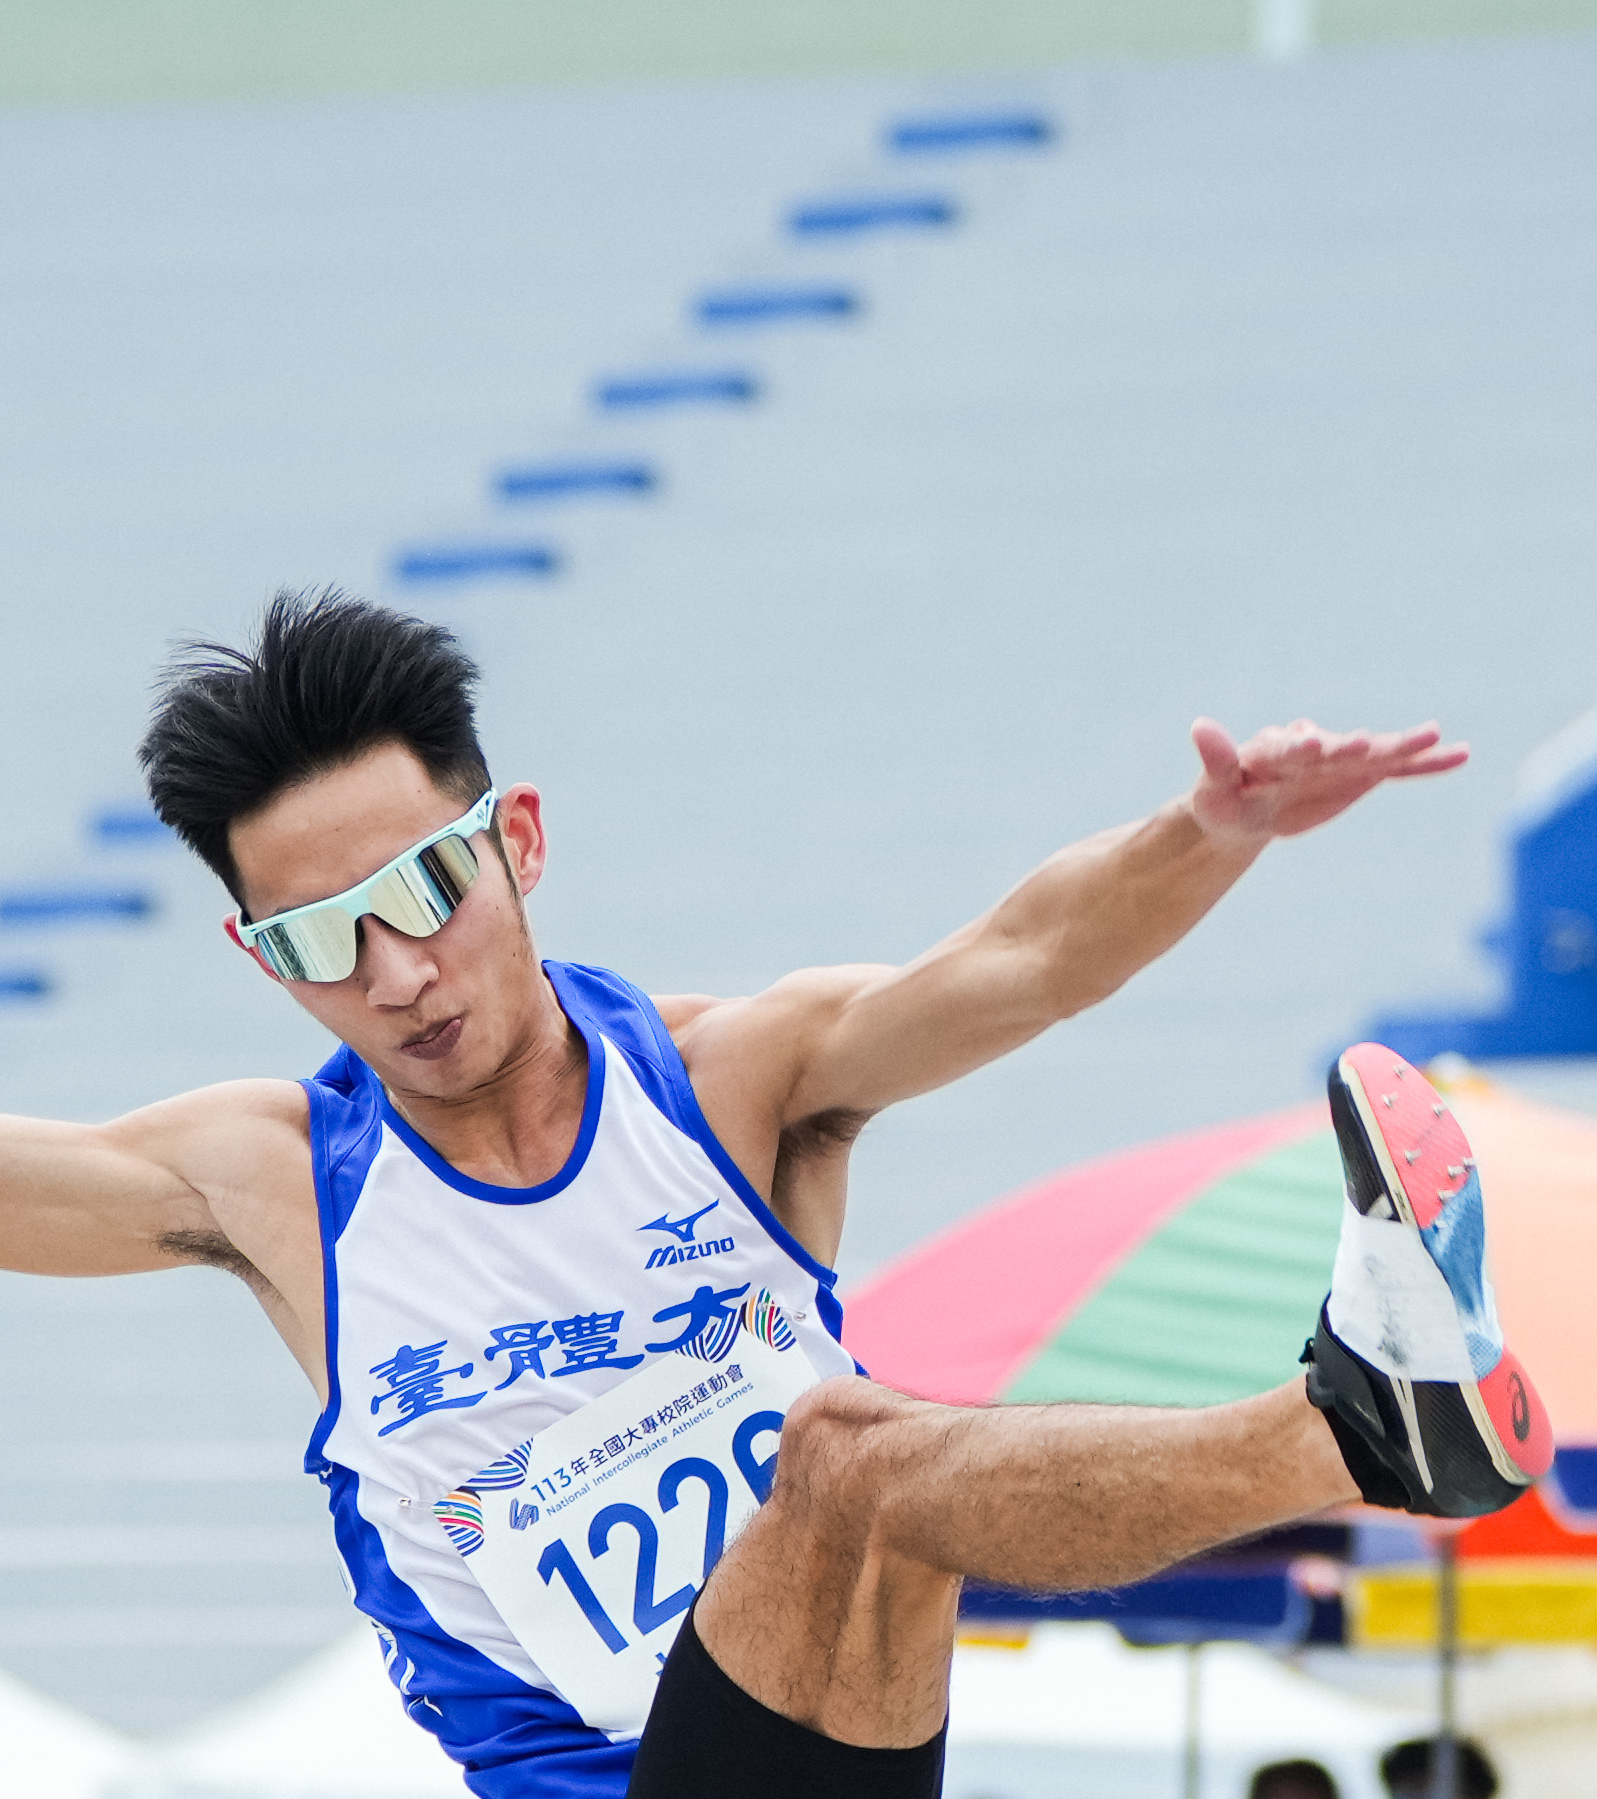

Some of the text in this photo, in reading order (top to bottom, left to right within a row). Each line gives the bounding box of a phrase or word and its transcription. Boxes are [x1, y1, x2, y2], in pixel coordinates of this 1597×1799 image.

[643, 1236, 735, 1271] MIZUNO
[369, 1281, 752, 1438] 臺體大
[530, 1363, 745, 1502] 113年全國大專校院運動會
[546, 1382, 755, 1517] National Intercollegiate Athletic Games
